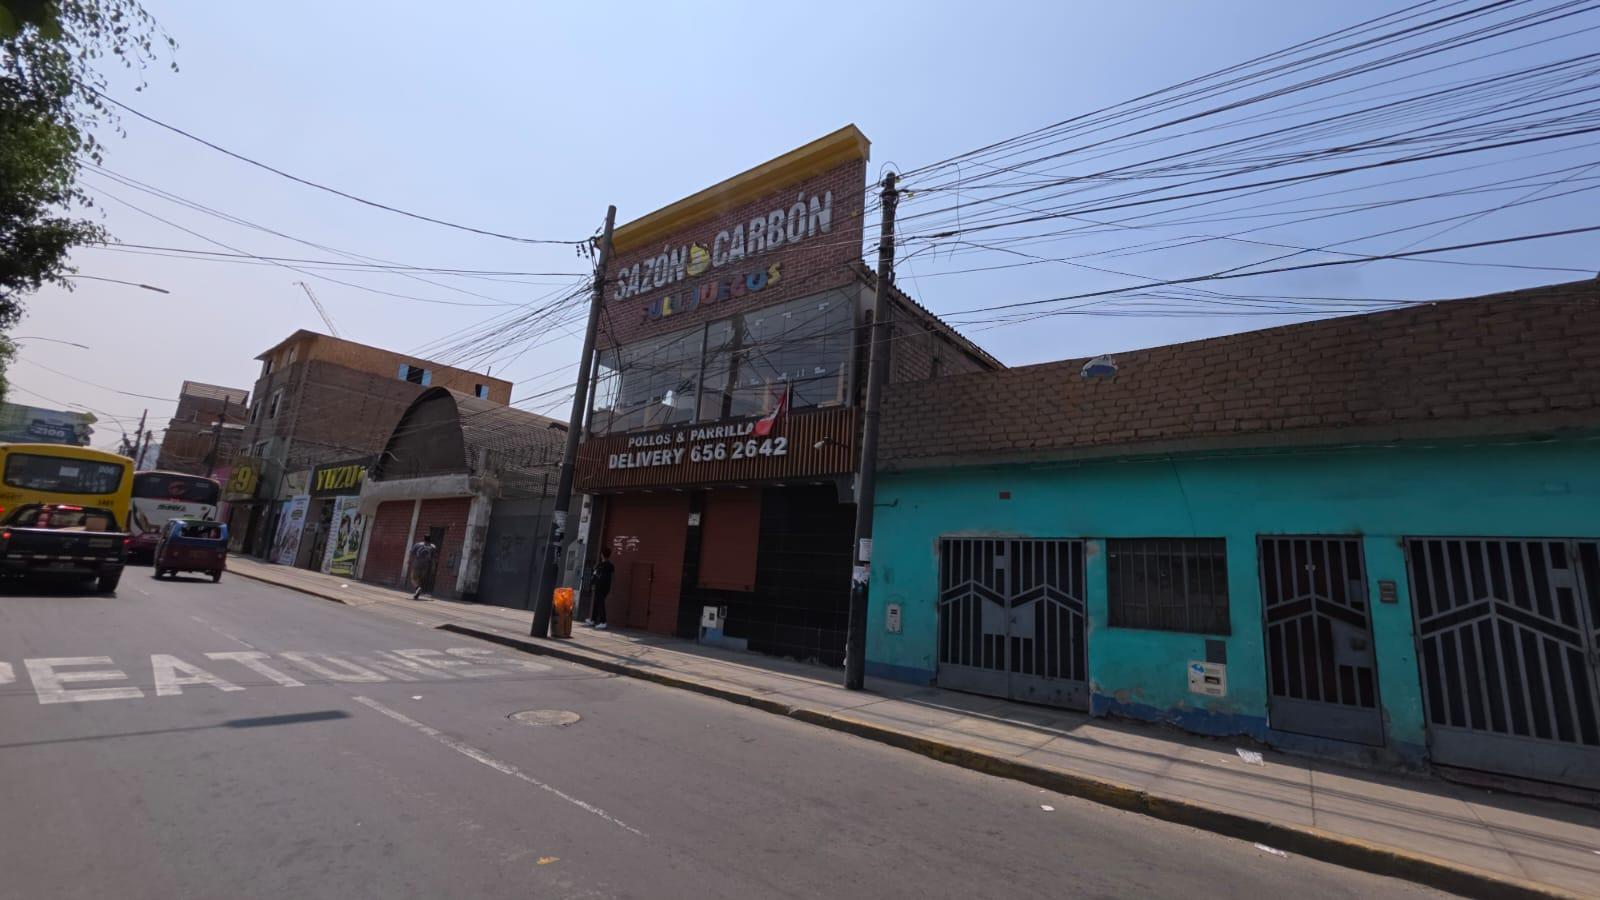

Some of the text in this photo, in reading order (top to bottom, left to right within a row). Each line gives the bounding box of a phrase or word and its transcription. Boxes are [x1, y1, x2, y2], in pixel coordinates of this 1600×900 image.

[614, 190, 832, 300] SAZÓN CARBÓN
[609, 437, 788, 470] DELIVERY 656 2642
[628, 433, 671, 448] POLLOS
[677, 432, 685, 443] &
